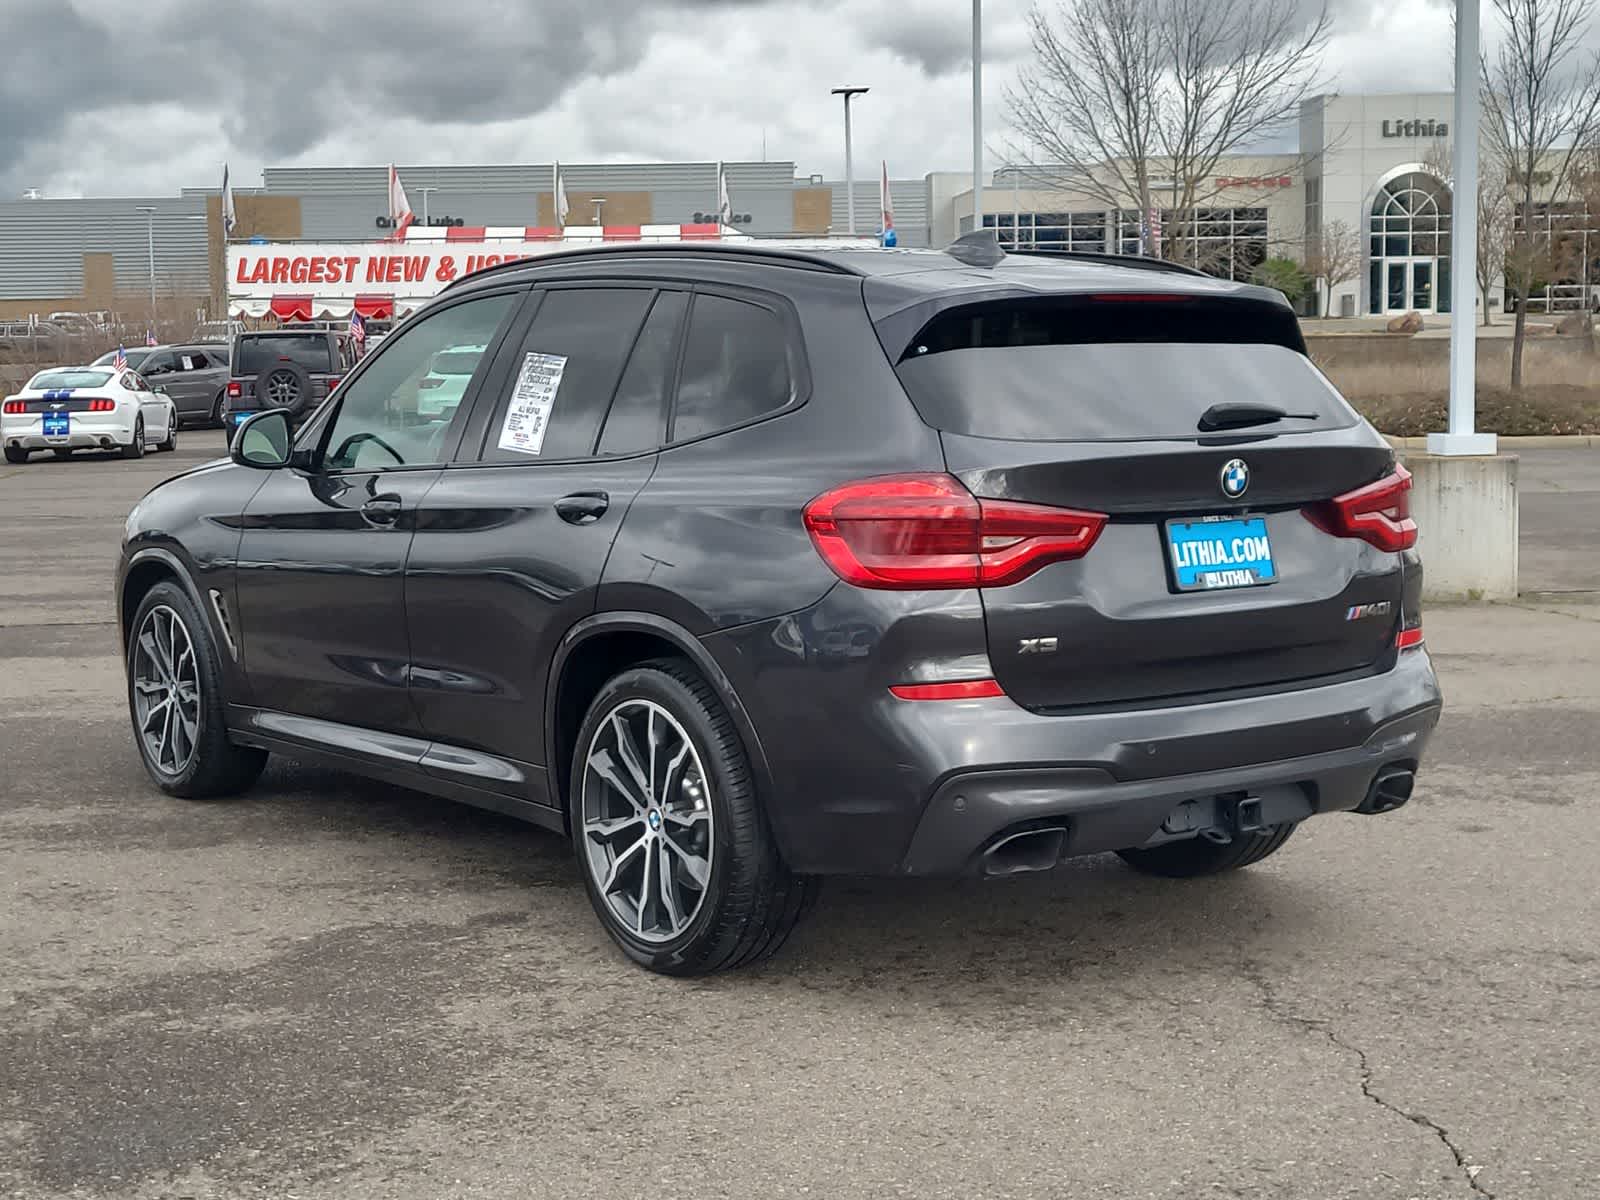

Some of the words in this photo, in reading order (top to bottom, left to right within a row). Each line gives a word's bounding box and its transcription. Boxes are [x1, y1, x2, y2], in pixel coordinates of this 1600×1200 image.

[1382, 119, 1449, 138] Lithia
[375, 216, 421, 228] Quk
[427, 216, 465, 228] Lube
[693, 211, 753, 224] Serce
[237, 257, 360, 283] LARGEST
[366, 255, 431, 283] NEW
[435, 255, 458, 282] &
[1173, 537, 1270, 567] LITHIA.COM
[1215, 569, 1254, 586] LITHIA
[1018, 636, 1058, 654] X3
